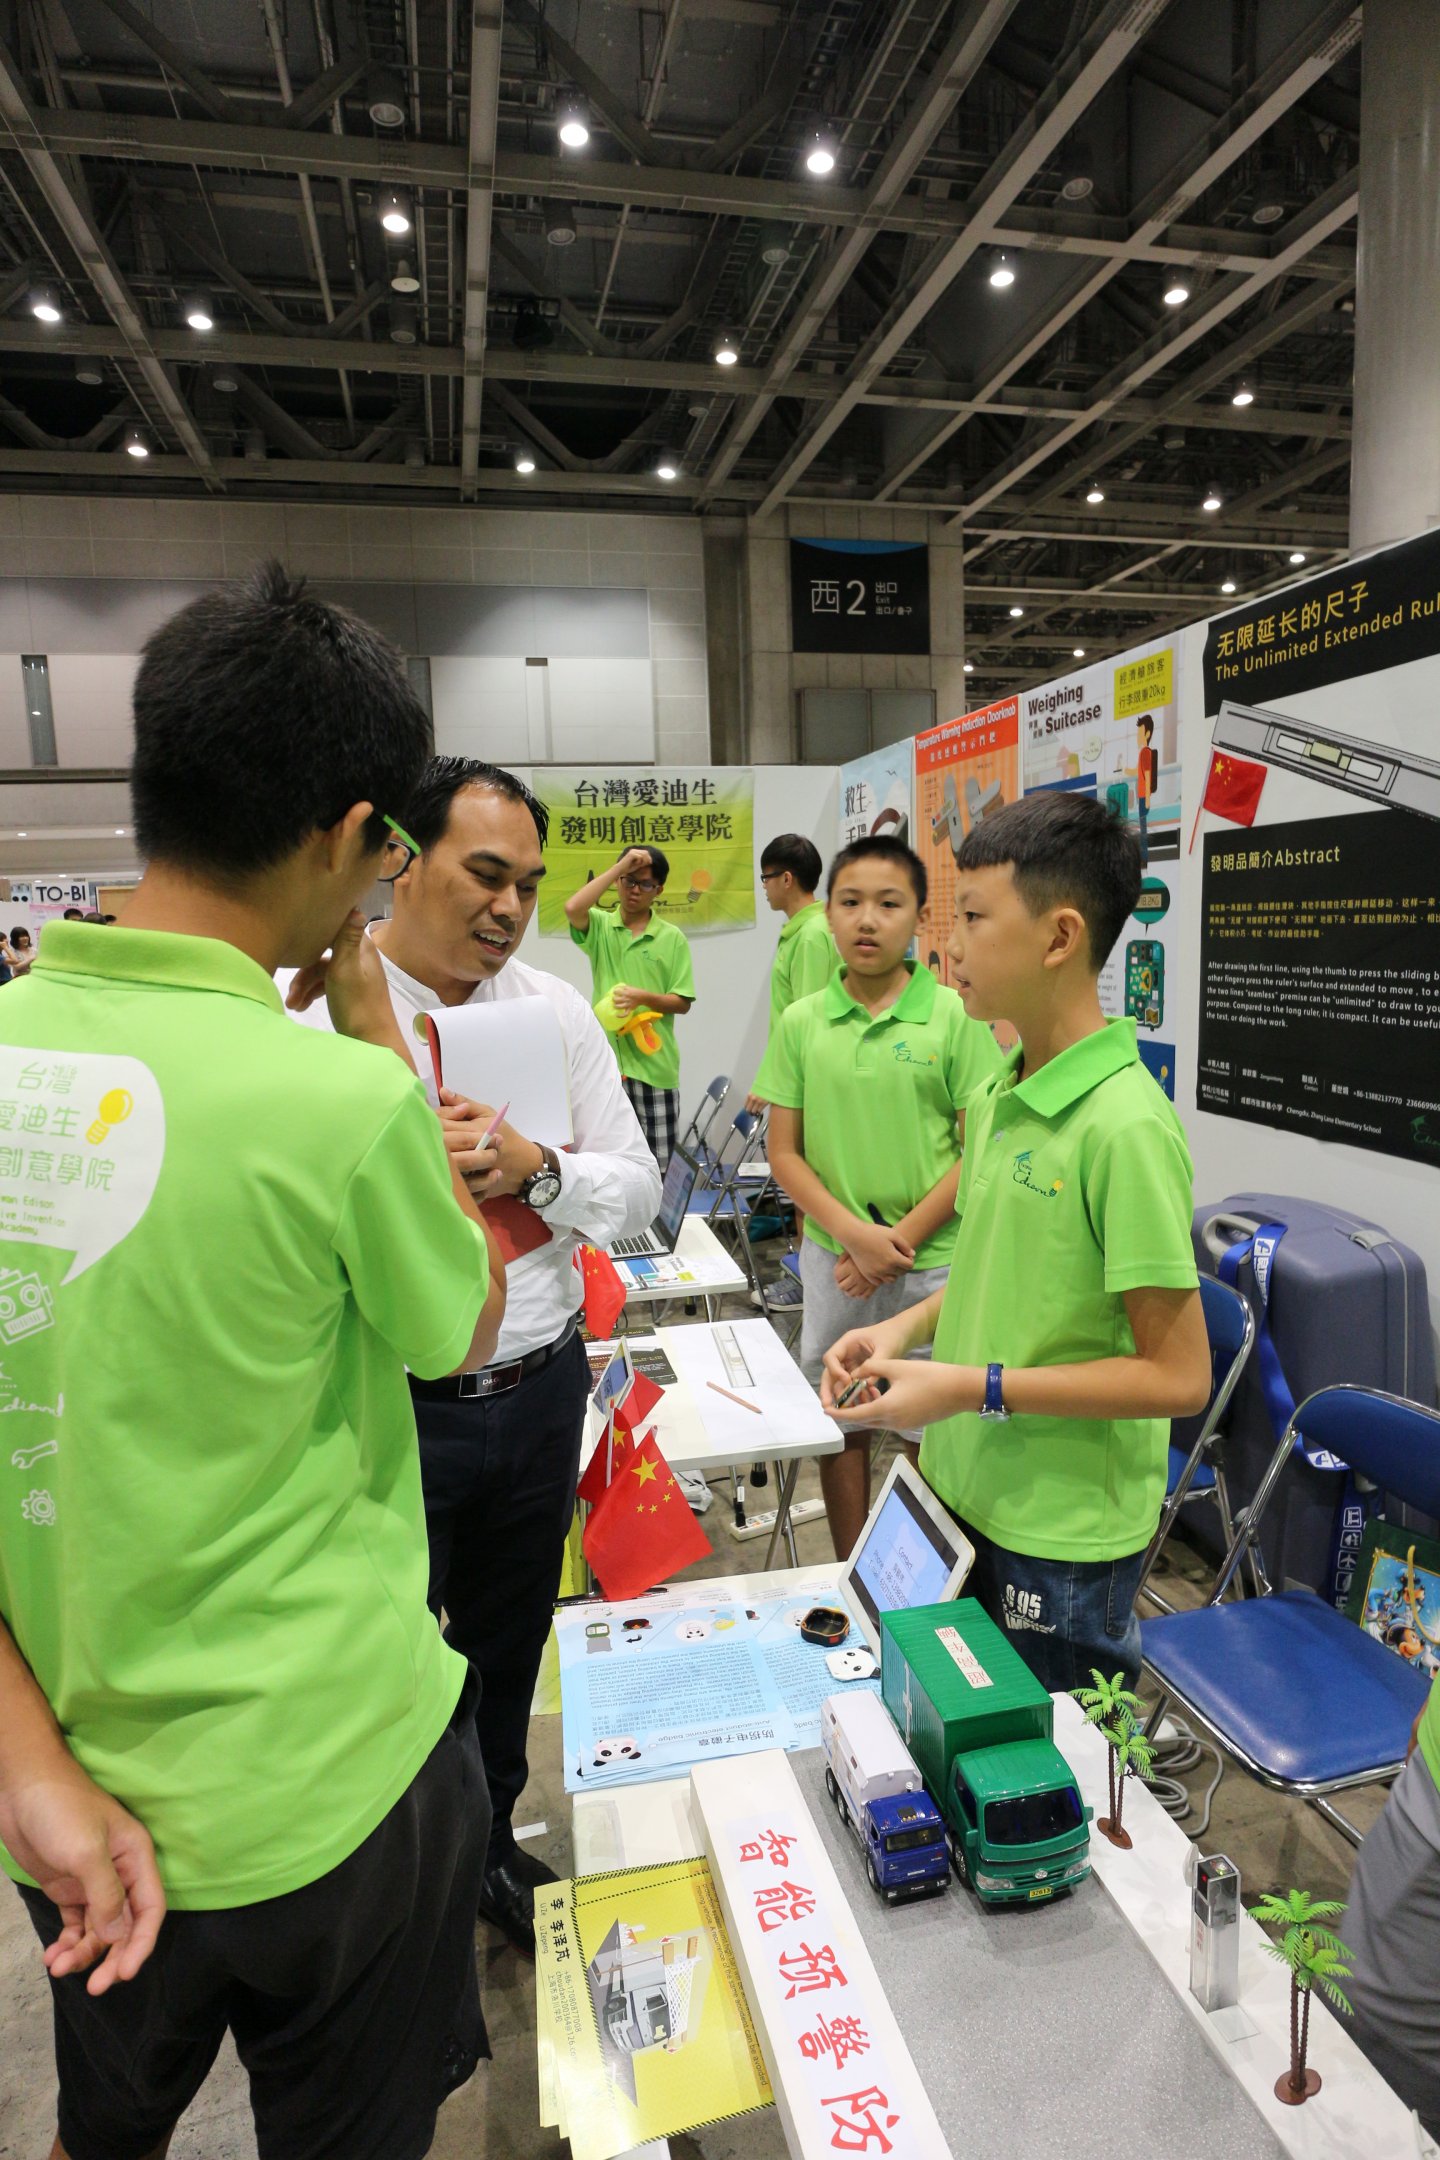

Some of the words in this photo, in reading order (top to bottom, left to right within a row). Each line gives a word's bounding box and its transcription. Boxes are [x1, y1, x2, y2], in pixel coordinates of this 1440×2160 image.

[875, 582, 897, 593] 出口
[875, 596, 890, 605] Exit
[1217, 581, 1369, 659] 无限延长的尺子
[1216, 664, 1239, 682] The
[1244, 635, 1318, 673] Unlimited
[1324, 605, 1403, 648] Extended
[1028, 684, 1084, 717] Weighing
[962, 716, 986, 733] Induction
[987, 703, 1016, 724] Doorknob
[1045, 704, 1102, 734] Suitcase
[574, 778, 718, 808] 台灣愛迪生
[560, 813, 733, 845] 發明創意學院
[1312, 965, 1322, 975] the
[1325, 967, 1347, 975] thumb
[1359, 970, 1381, 978] press
[1384, 969, 1398, 978] the
[1401, 970, 1430, 982] sliding
[1300, 979, 1323, 989] surface
[1326, 981, 1338, 990] and
[1340, 983, 1375, 992] extended
[1378, 985, 1387, 993] to
[1390, 986, 1413, 995] move
[1422, 987, 1431, 996] to
[1280, 992, 1307, 1001] premise
[1323, 995, 1330, 1003] be
[1390, 1000, 1411, 1010] draw
[1414, 1003, 1423, 1011] to
[1269, 1019, 1288, 1027] work.
[1323, 1010, 1327, 1018] it
[1329, 1010, 1334, 1019] is
[1336, 1012, 1370, 1022] compact.
[1372, 1014, 1379, 1023] It
[1382, 1017, 1396, 1025] can
[1400, 1016, 1410, 1026] be
[17, 1061, 78, 1094] 台灣
[1335, 1117, 1362, 1131] Elementary
[1363, 1124, 1382, 1134] School
[23, 1195, 55, 1209] Edison
[23, 1211, 65, 1228] Invention
[735, 1999, 749, 2029] accident
[744, 2029, 754, 2043] can
[750, 2043, 759, 2055] be
[753, 2056, 769, 2086] avoided
